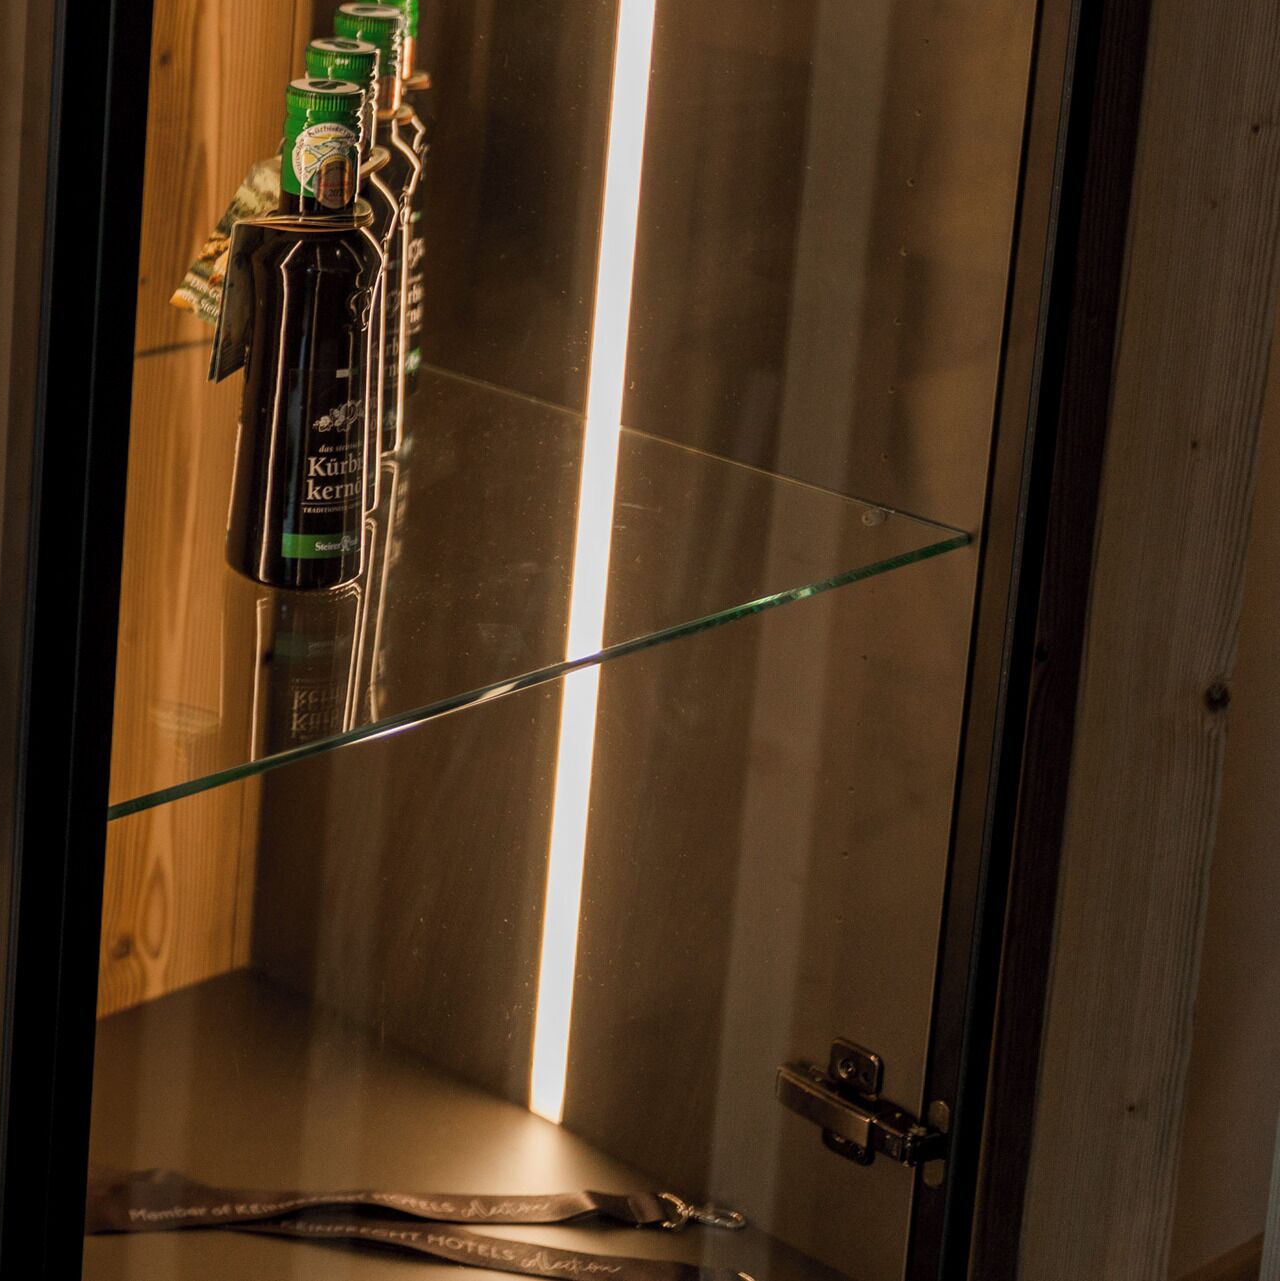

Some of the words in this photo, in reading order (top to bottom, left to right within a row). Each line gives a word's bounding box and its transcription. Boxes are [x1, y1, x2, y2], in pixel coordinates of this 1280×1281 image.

[308, 453, 361, 477] Kürbi
[306, 478, 361, 500] kernö
[427, 1233, 516, 1261] HOTELS
